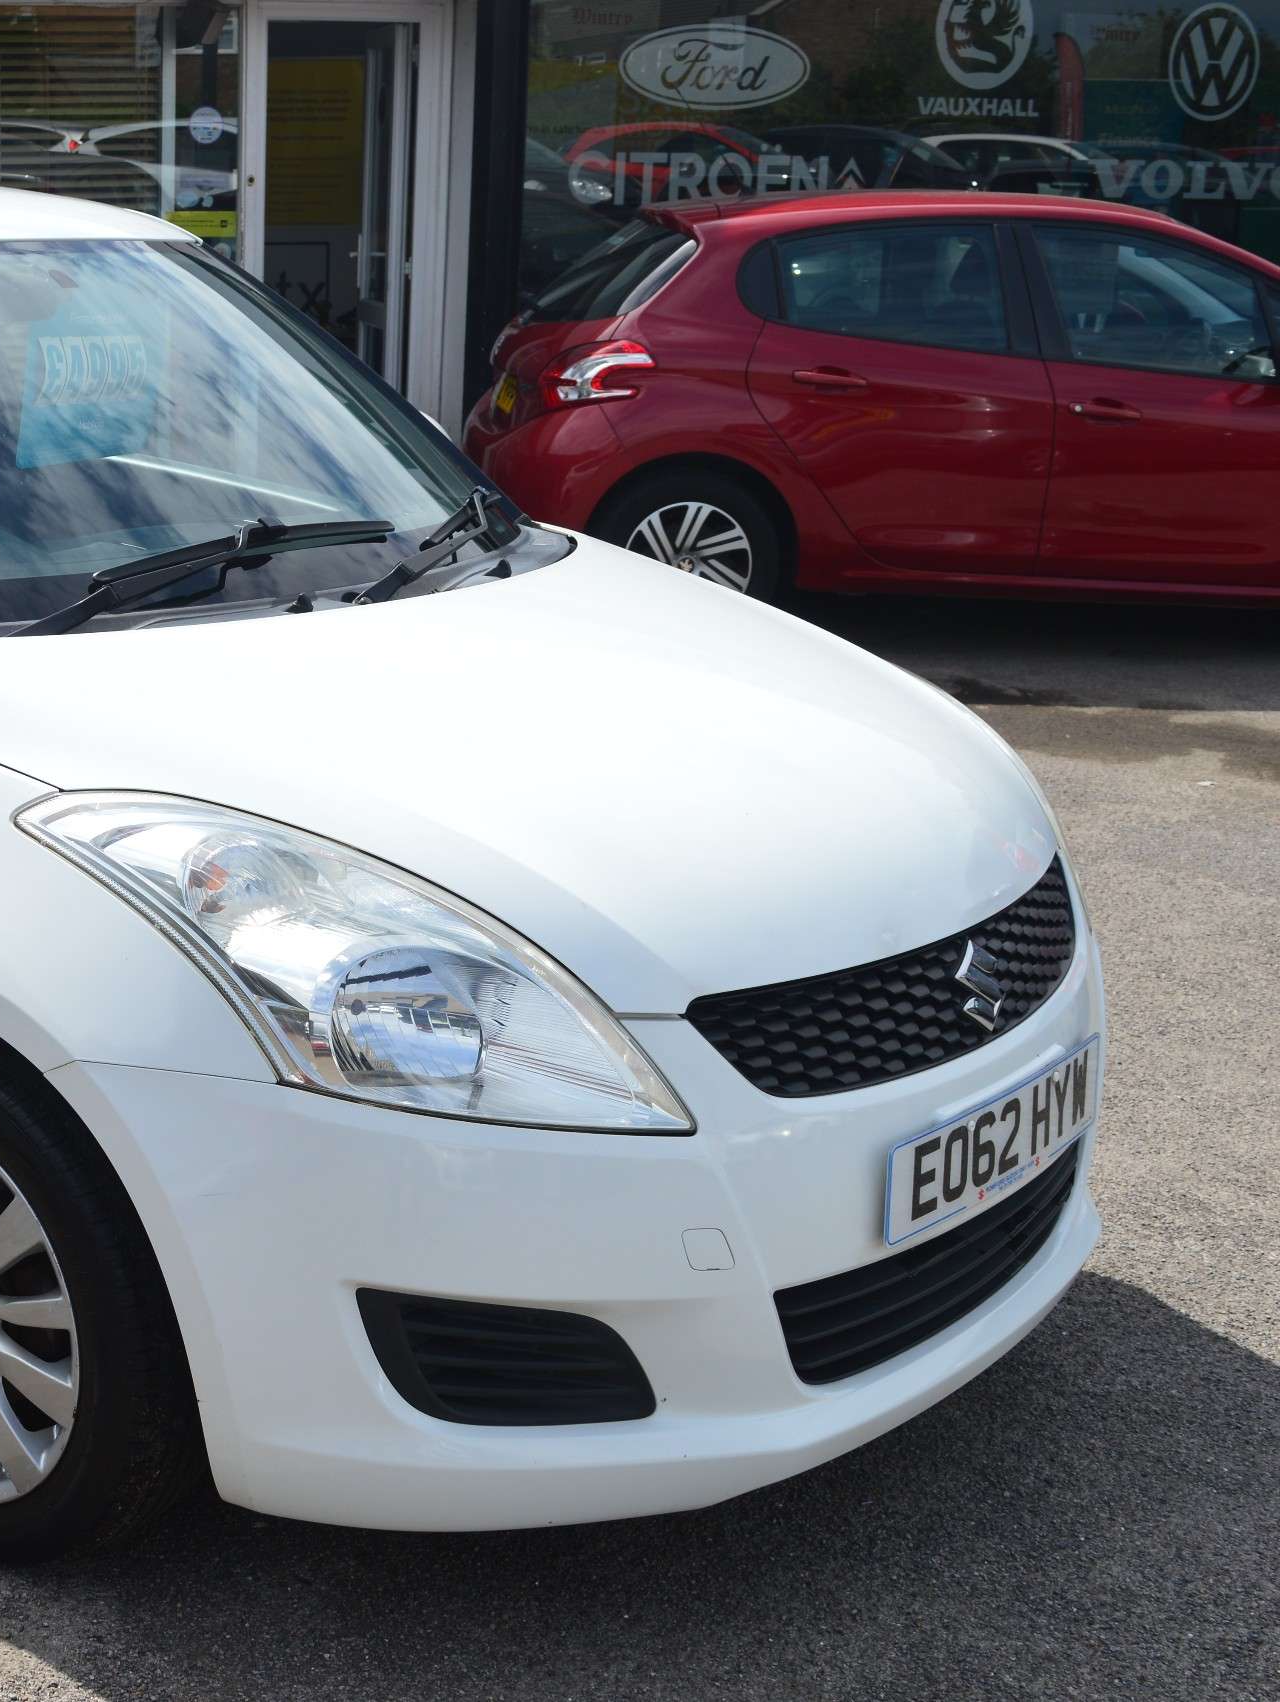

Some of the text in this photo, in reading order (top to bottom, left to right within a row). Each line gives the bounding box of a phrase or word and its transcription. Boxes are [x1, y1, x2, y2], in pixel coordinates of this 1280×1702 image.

[660, 38, 768, 92] Ford
[917, 96, 1039, 118] VAUXHALL
[568, 142, 830, 206] CITROËN
[1090, 158, 1280, 201] VOLV
[1031, 1050, 1089, 1156] HYW
